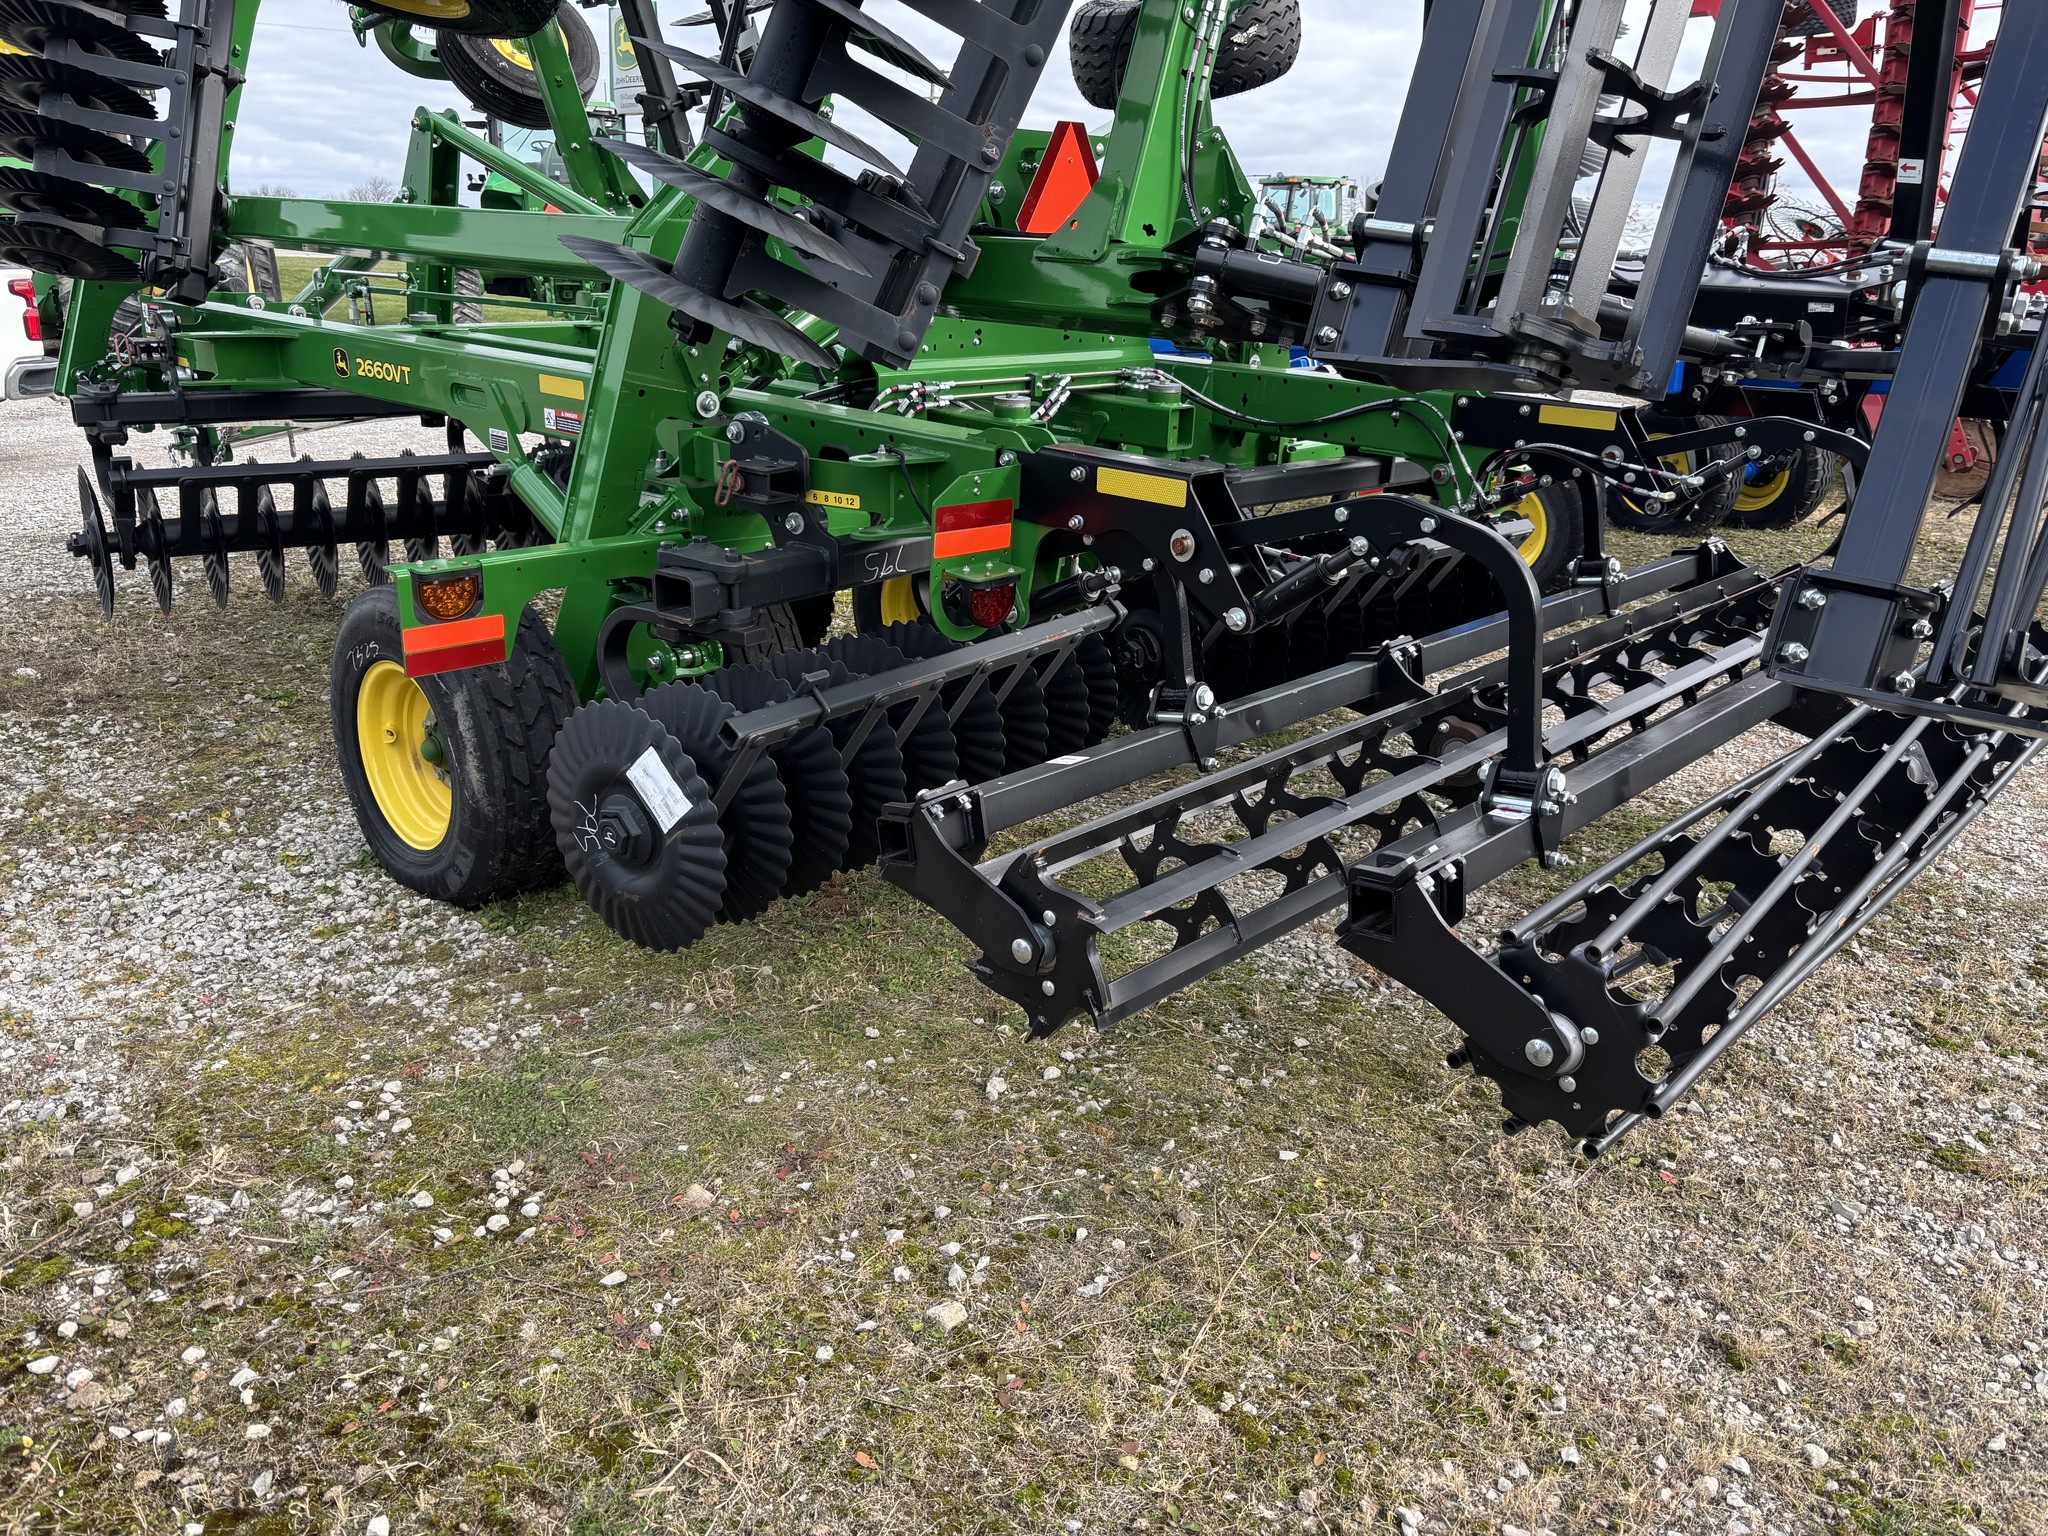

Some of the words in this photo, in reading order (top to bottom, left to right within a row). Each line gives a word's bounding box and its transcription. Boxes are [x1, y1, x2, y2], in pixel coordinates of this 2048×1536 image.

[356, 357, 411, 385] 2660VT
[812, 493, 818, 501] 6
[824, 494, 829, 502] 8
[833, 496, 843, 504] 10
[845, 497, 855, 506] 12
